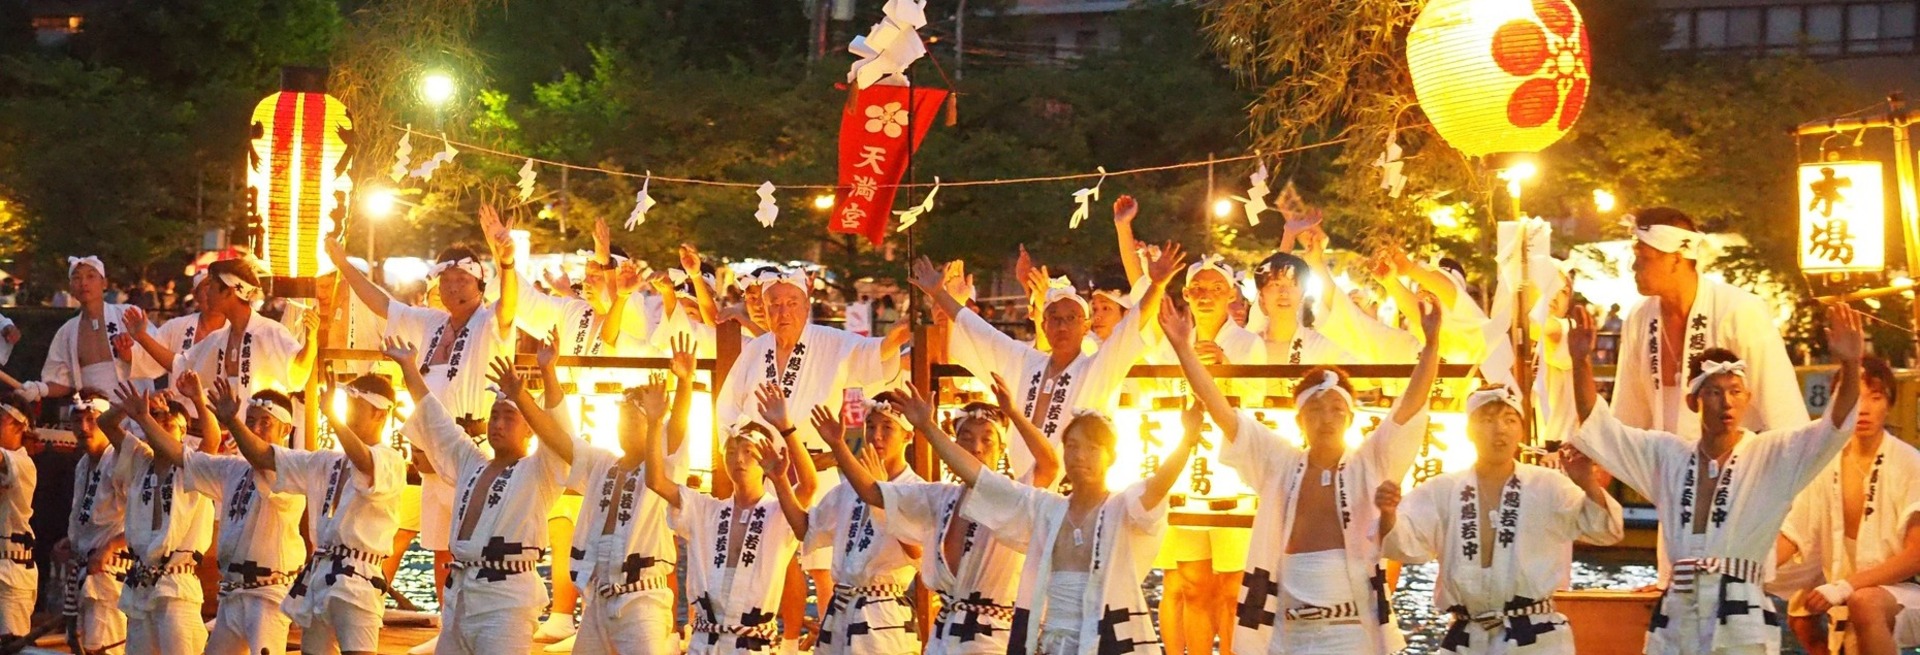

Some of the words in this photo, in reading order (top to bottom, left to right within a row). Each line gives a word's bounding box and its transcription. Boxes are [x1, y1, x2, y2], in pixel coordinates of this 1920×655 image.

[841, 145, 887, 229] 天満宮
[1025, 371, 1042, 418] 木場若
[1044, 372, 1071, 438] 木場若中
[1809, 384, 1827, 408] 8
[714, 506, 732, 569] 木場若中
[742, 506, 766, 567] 木場若中
[1460, 485, 1478, 561] 木場若中
[1499, 474, 1521, 549] 木場若中
